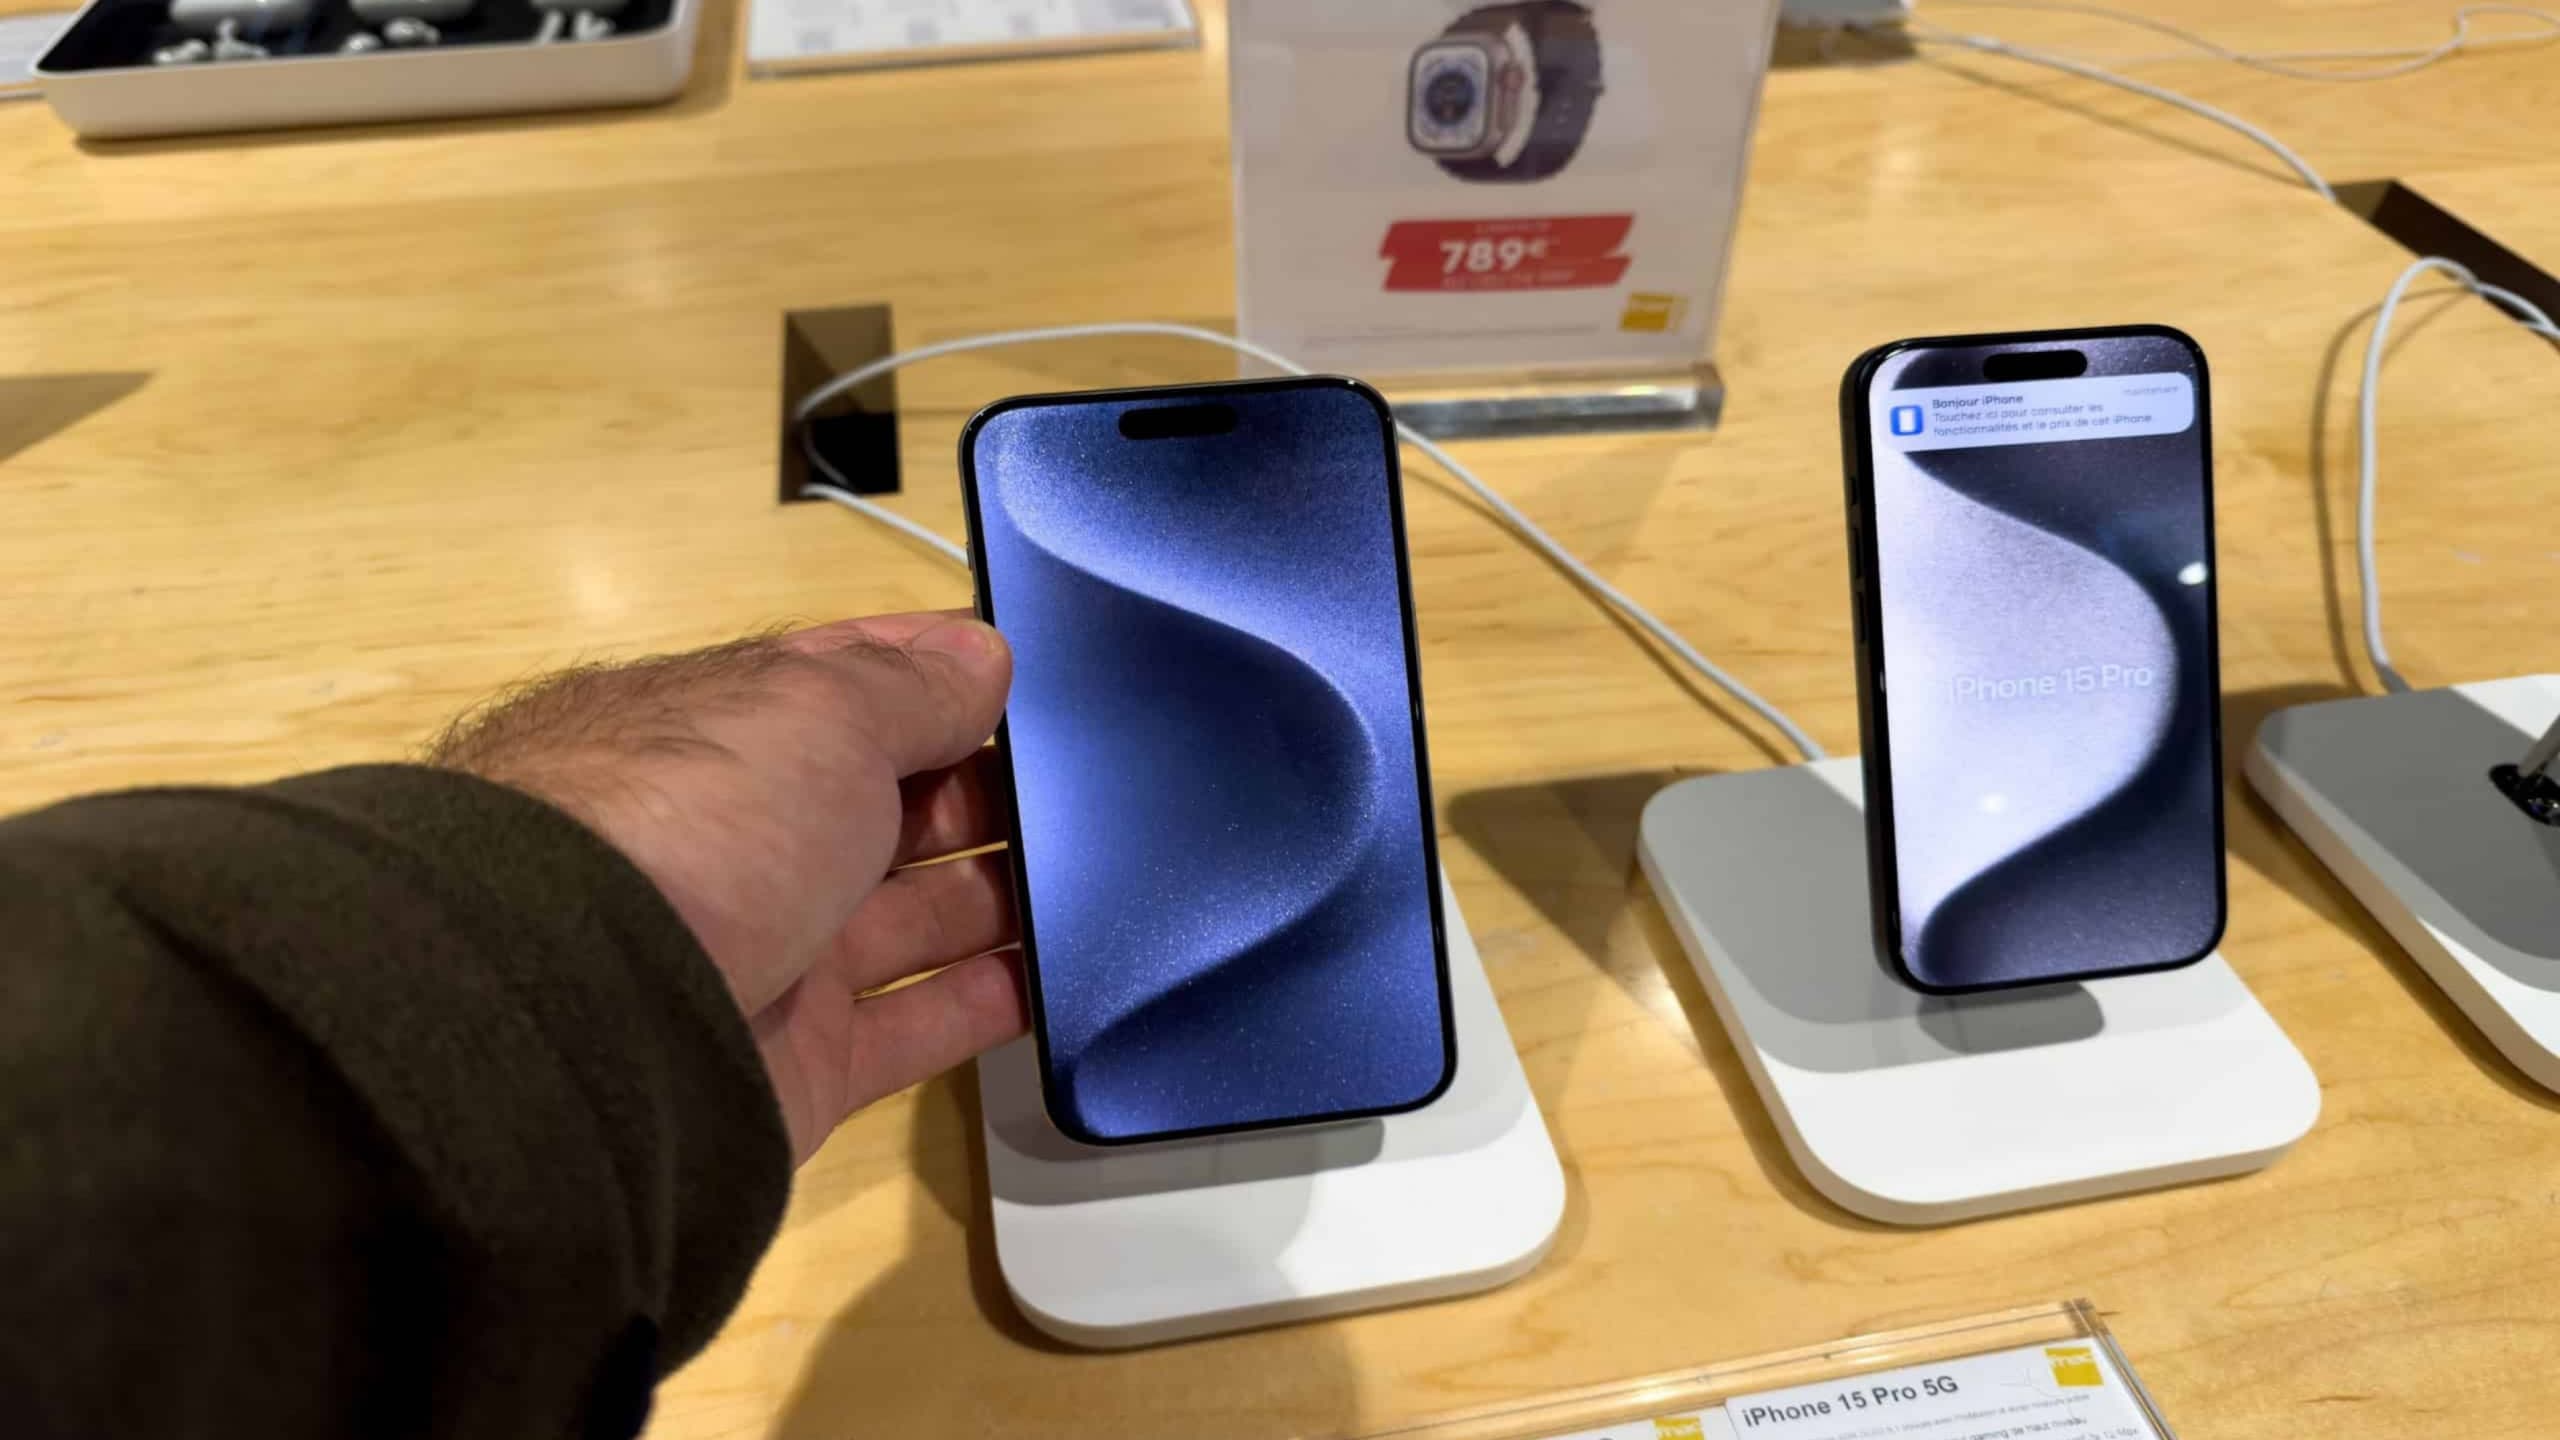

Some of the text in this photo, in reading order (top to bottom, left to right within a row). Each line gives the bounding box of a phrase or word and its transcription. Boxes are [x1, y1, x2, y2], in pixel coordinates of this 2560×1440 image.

[1440, 238, 1548, 274] 789€
[1932, 396, 2023, 409] Bonjour iPhone
[1933, 404, 2103, 422] Touchez ici pour consulter les
[1934, 422, 2018, 437] fonctionnalités
[2022, 421, 2033, 430] et
[2036, 419, 2046, 429] le
[2049, 419, 2071, 430] prix
[2074, 418, 2088, 427] de
[2091, 416, 2109, 426] cet
[1953, 664, 2153, 704] iPhone 15 Pro
[1742, 1375, 1959, 1428] iPhone 15 Pro 5G
